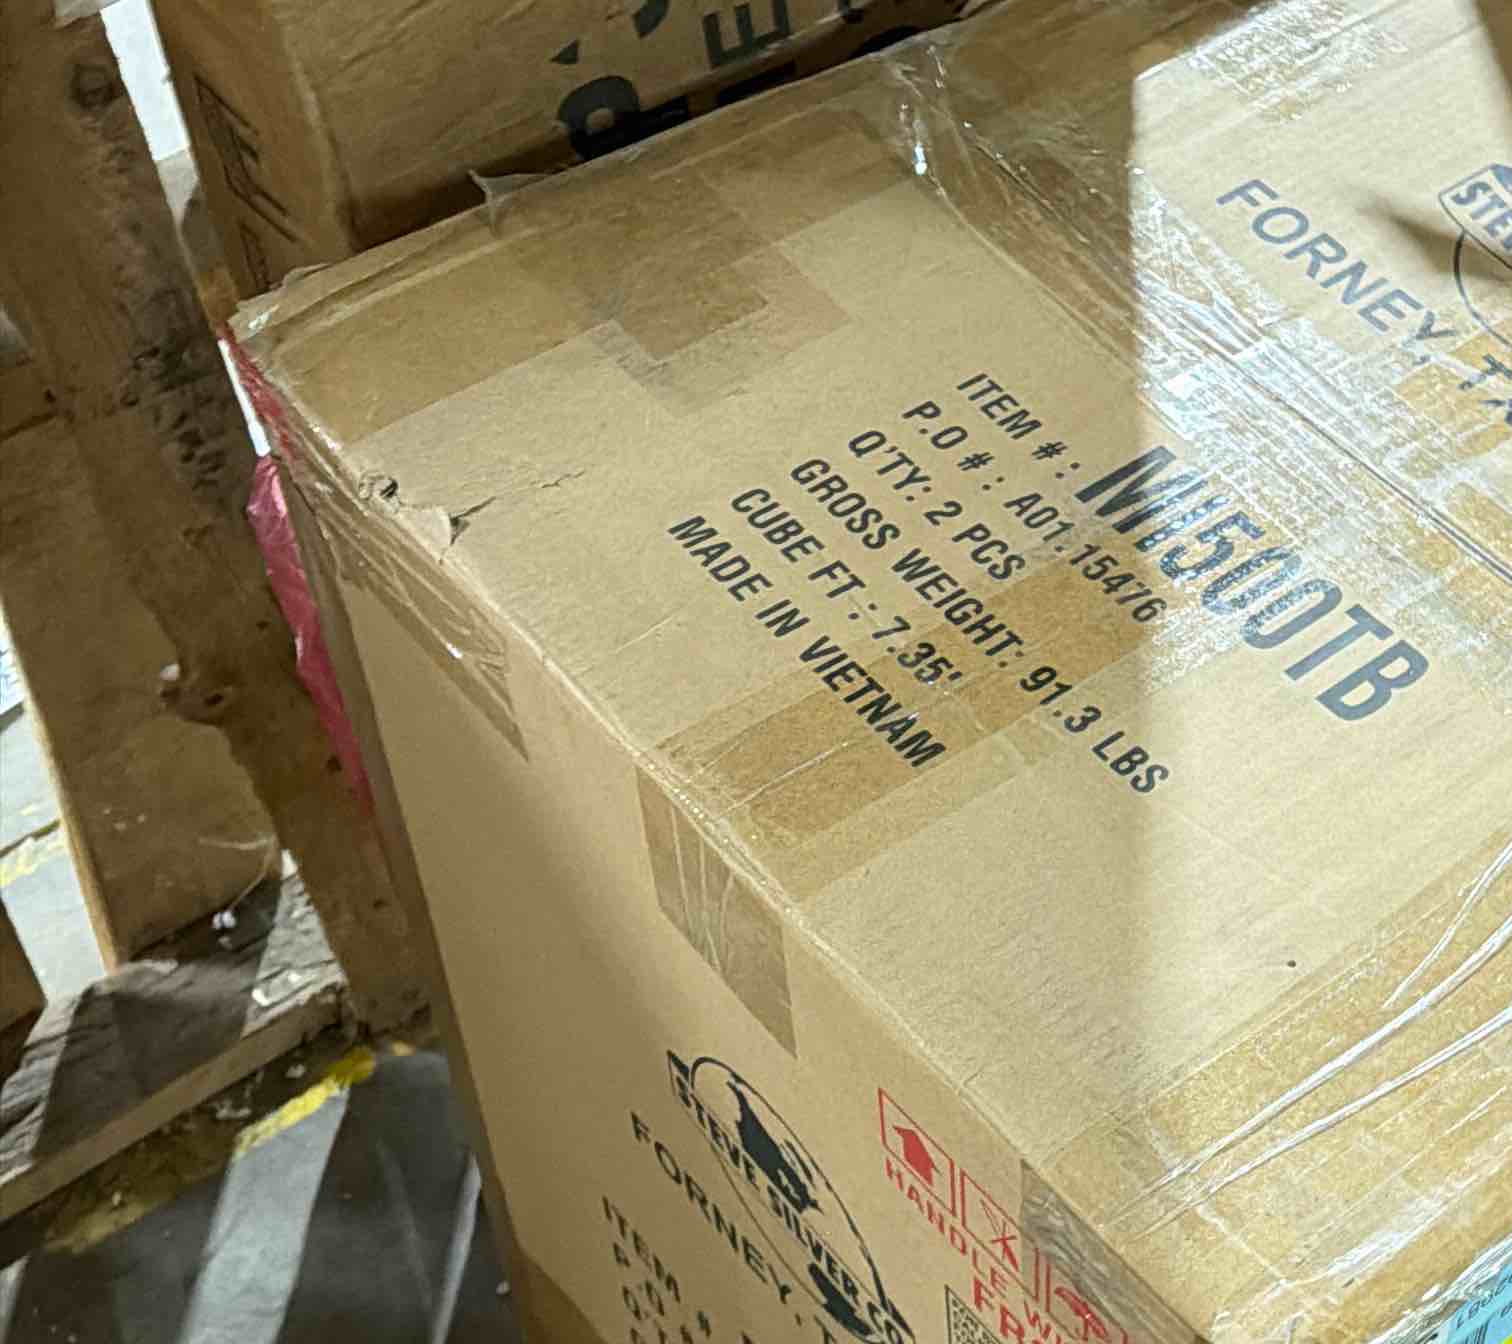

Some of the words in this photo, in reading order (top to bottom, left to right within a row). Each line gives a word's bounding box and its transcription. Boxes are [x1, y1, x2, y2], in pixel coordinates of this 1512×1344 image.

[1216, 178, 1456, 367] FORNEY,
[848, 430, 932, 503] Q'TY:
[924, 499, 964, 527] 2
[951, 522, 1027, 582] PCS
[956, 373, 1042, 441] ITEM
[731, 487, 826, 565] CUBE
[902, 399, 969, 451] P.O
[1003, 493, 1169, 624] A01.15476
[667, 515, 774, 603] MADE
[755, 598, 812, 639] IN
[798, 635, 948, 770] VIETNAM
[789, 457, 901, 552] GROSS
[890, 547, 1025, 670] WEIGHT:
[1018, 664, 1104, 736] 91.3
[1090, 730, 1171, 796] LBS
[629, 1110, 804, 1327] FORNEY,
[674, 1074, 764, 1192] STEVE
[766, 1182, 862, 1306] SILVER
[884, 1155, 1009, 1294] HANDLE
